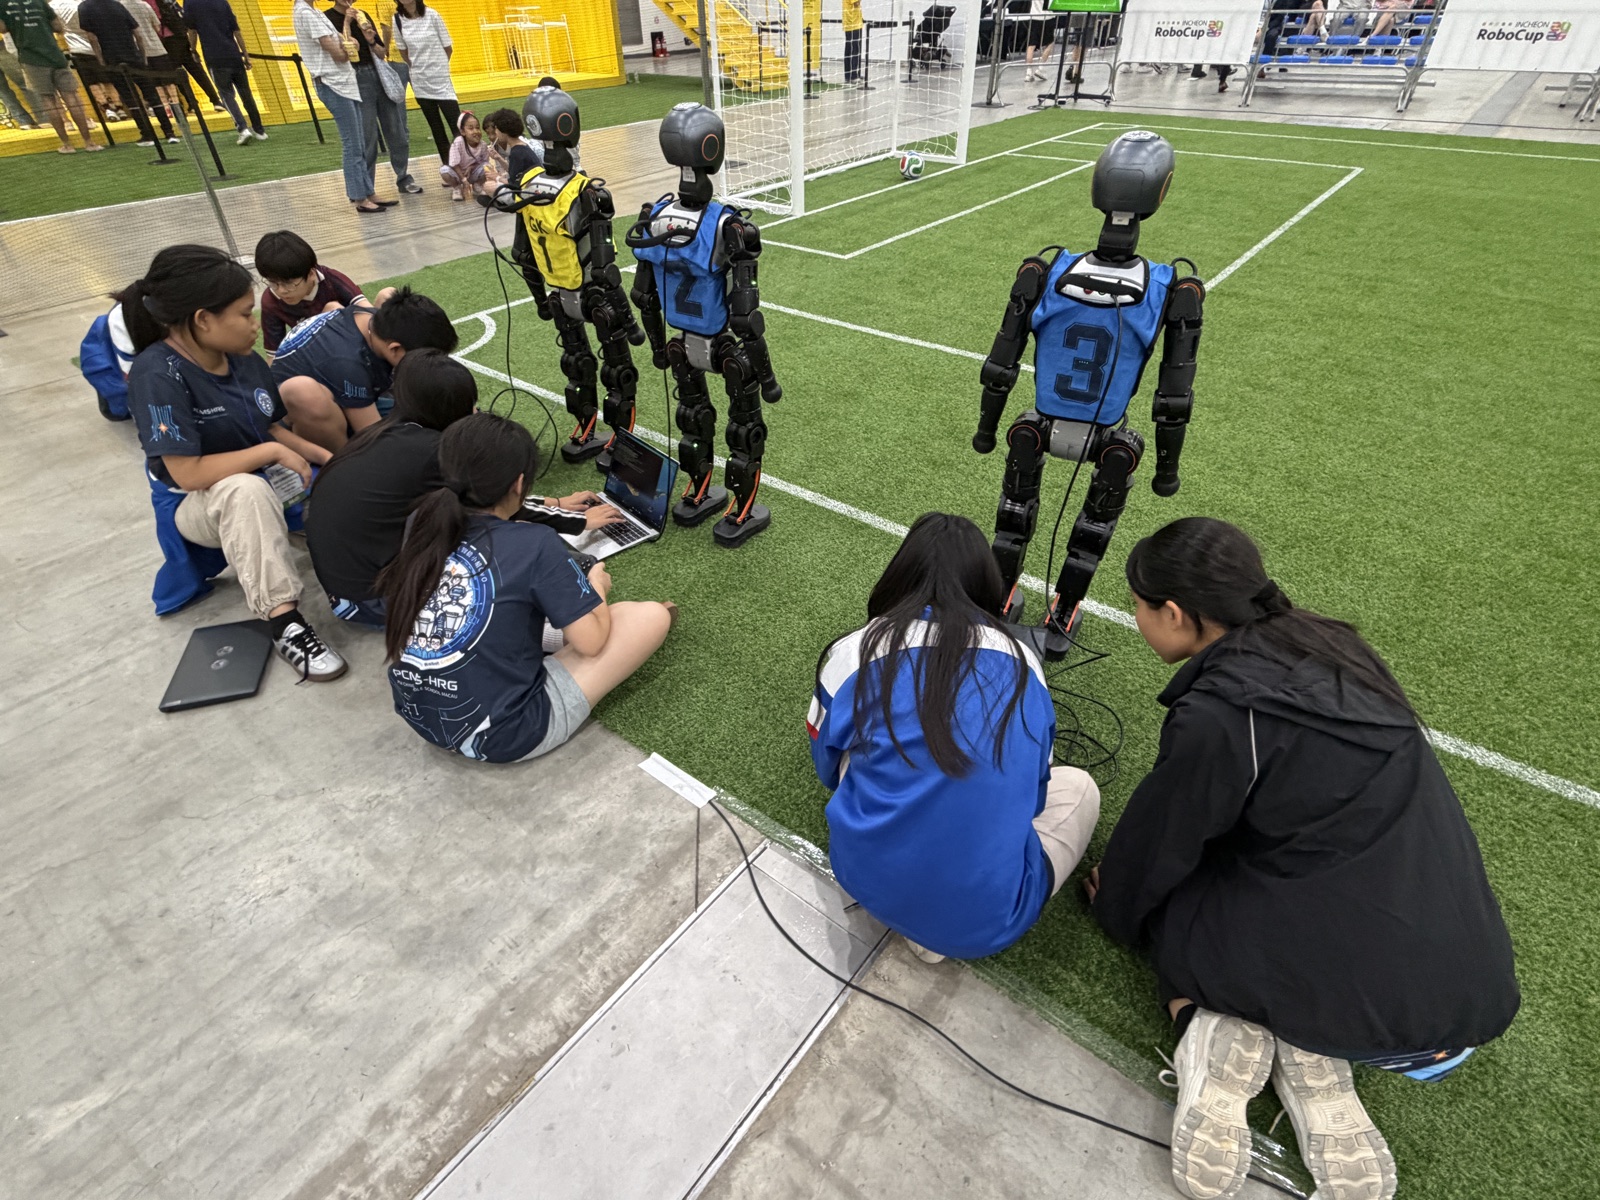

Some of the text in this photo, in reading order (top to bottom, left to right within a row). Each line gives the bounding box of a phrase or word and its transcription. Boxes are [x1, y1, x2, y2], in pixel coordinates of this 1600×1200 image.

[1154, 26, 1205, 40] RoboCup
[1476, 29, 1544, 44] RoboCup
[529, 216, 549, 234] GK
[537, 235, 554, 275] 1
[660, 257, 704, 319] 2
[1054, 322, 1114, 405] 3
[424, 686, 441, 696] SCHOOL
